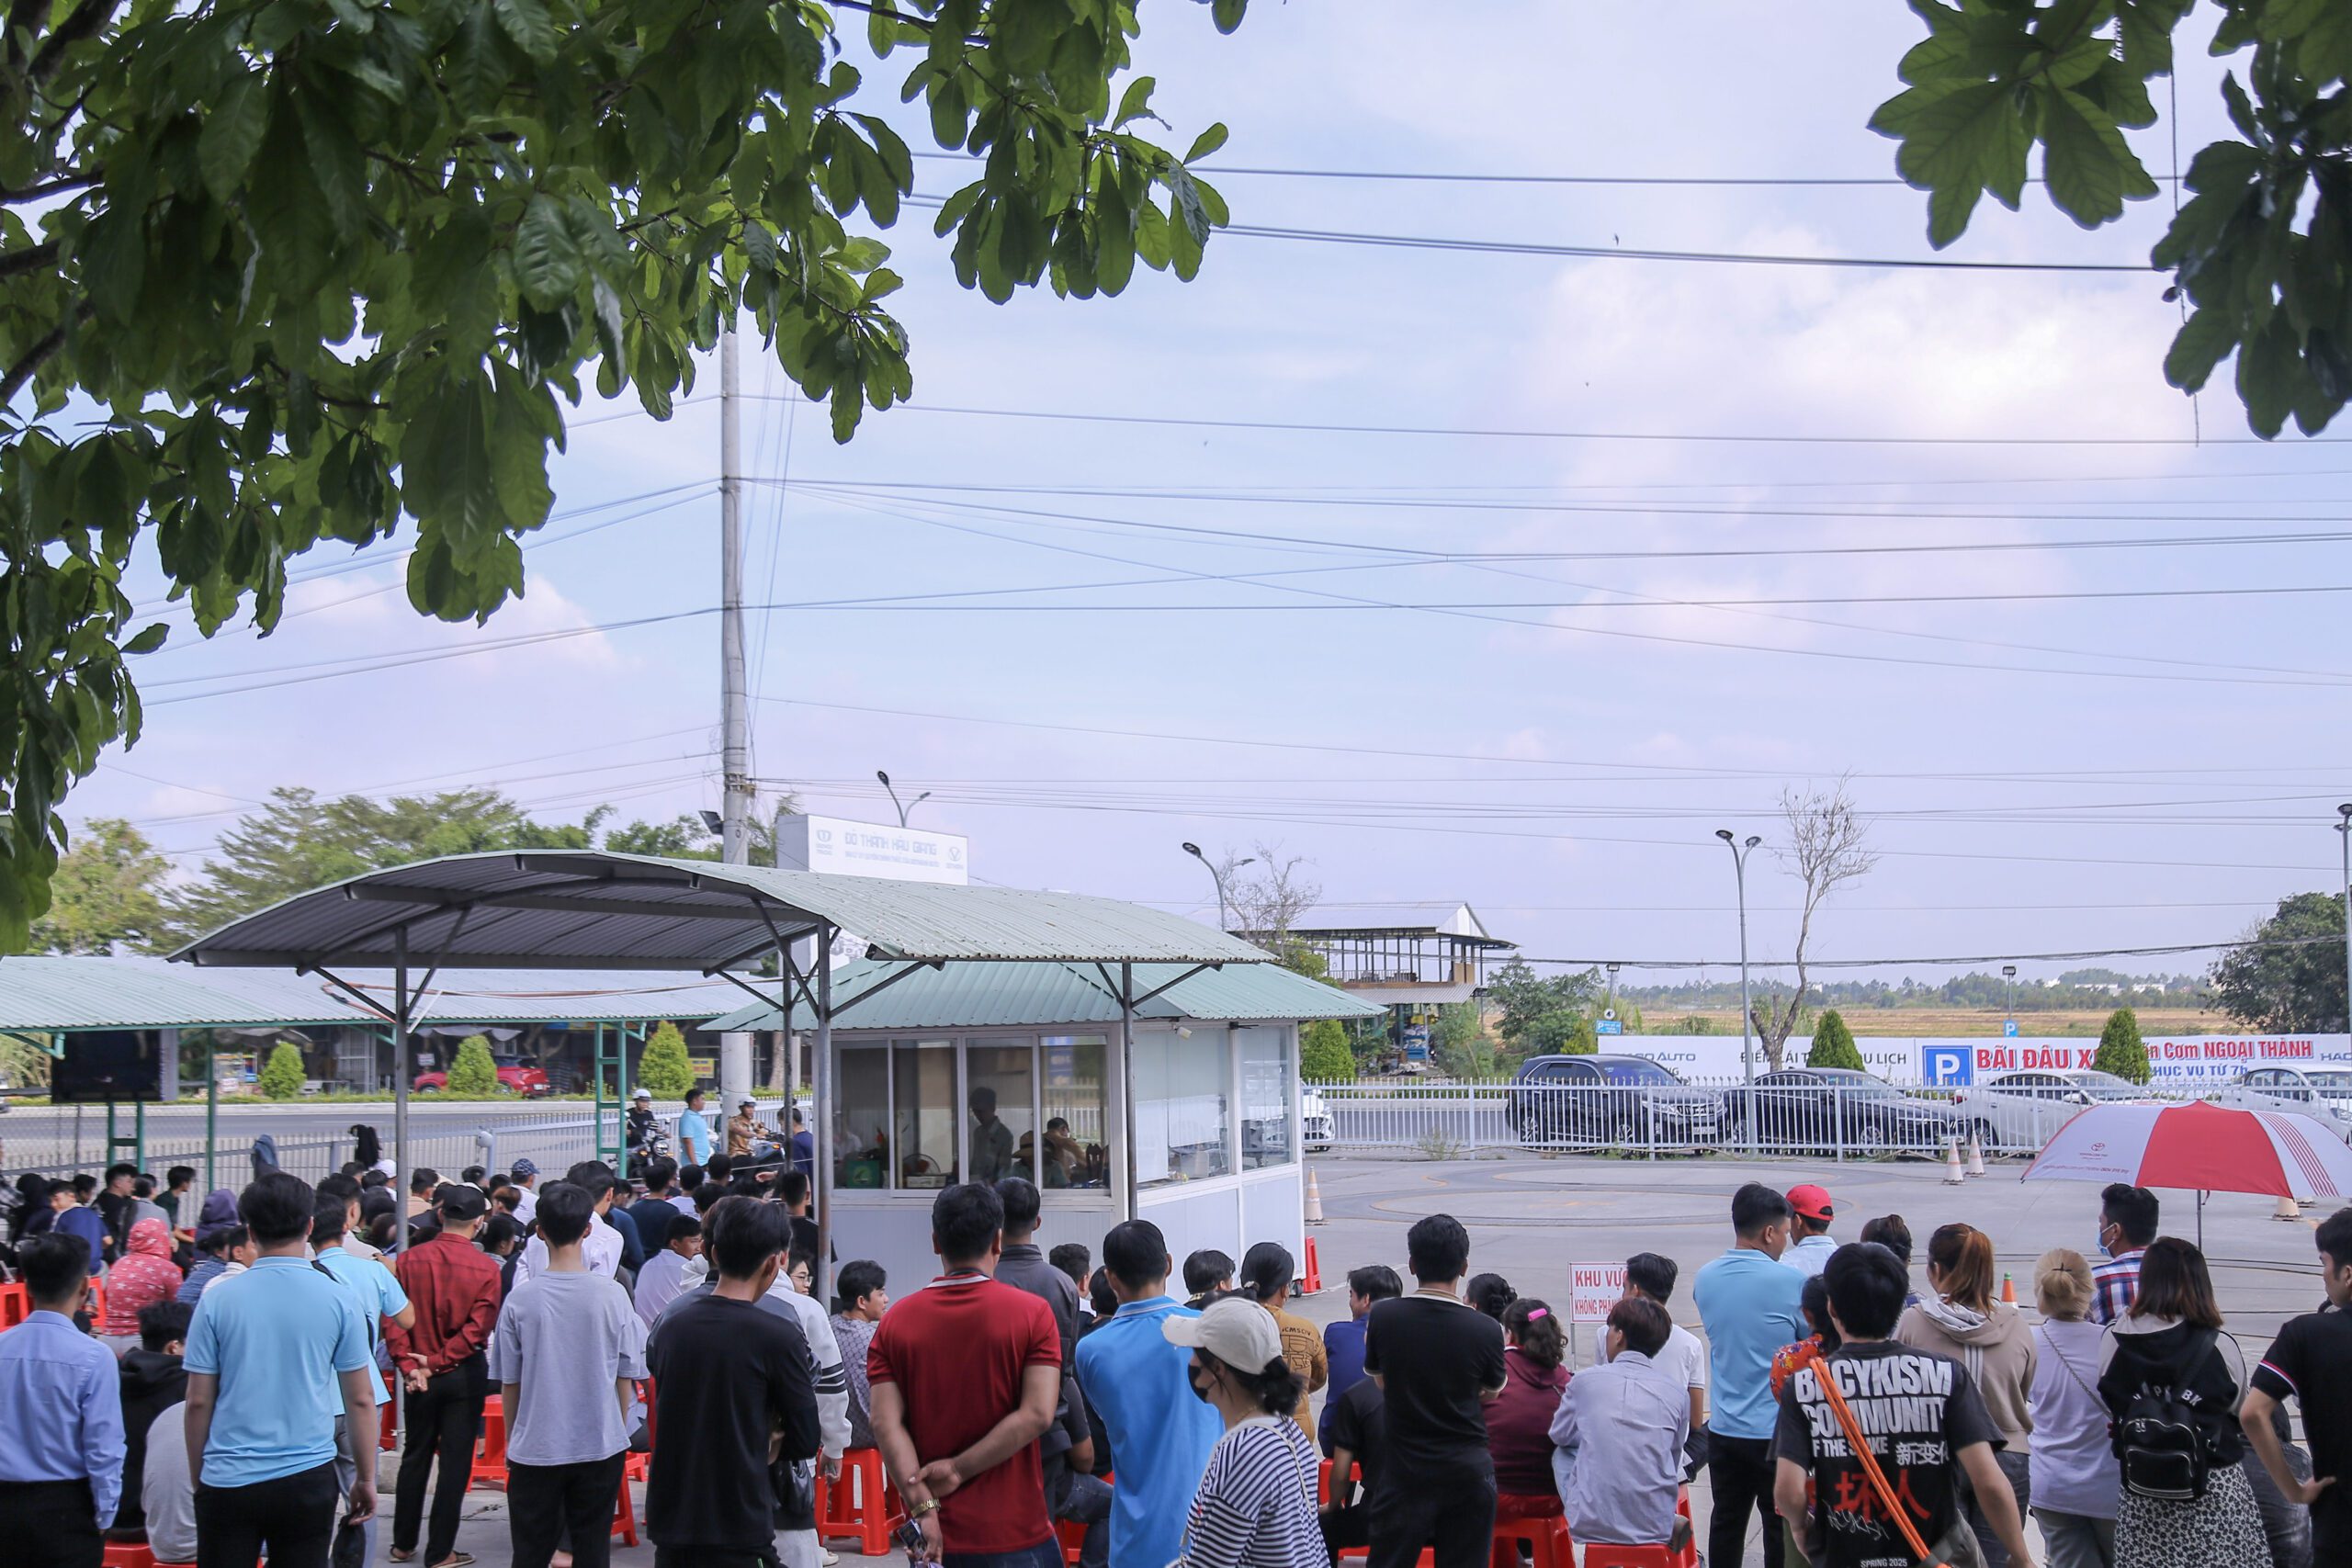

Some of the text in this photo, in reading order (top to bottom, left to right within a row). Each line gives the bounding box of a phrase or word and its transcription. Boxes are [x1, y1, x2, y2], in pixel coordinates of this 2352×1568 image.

[2005, 1022, 2016, 1036] P
[1657, 1052, 1696, 1061] AUTO
[1976, 1044, 2017, 1071] BÃI
[2204, 1041, 2255, 1064] NGOẠI
[2258, 1038, 2313, 1059] THÀNH
[1935, 1054, 1961, 1086] P
[1575, 1270, 1601, 1287] KHU
[1575, 1295, 1598, 1314] KHÔNG
[1822, 1438, 1848, 1458] THE
[1848, 1436, 1889, 1457] SKE
[1860, 1558, 1907, 1568] SPRING 2025
